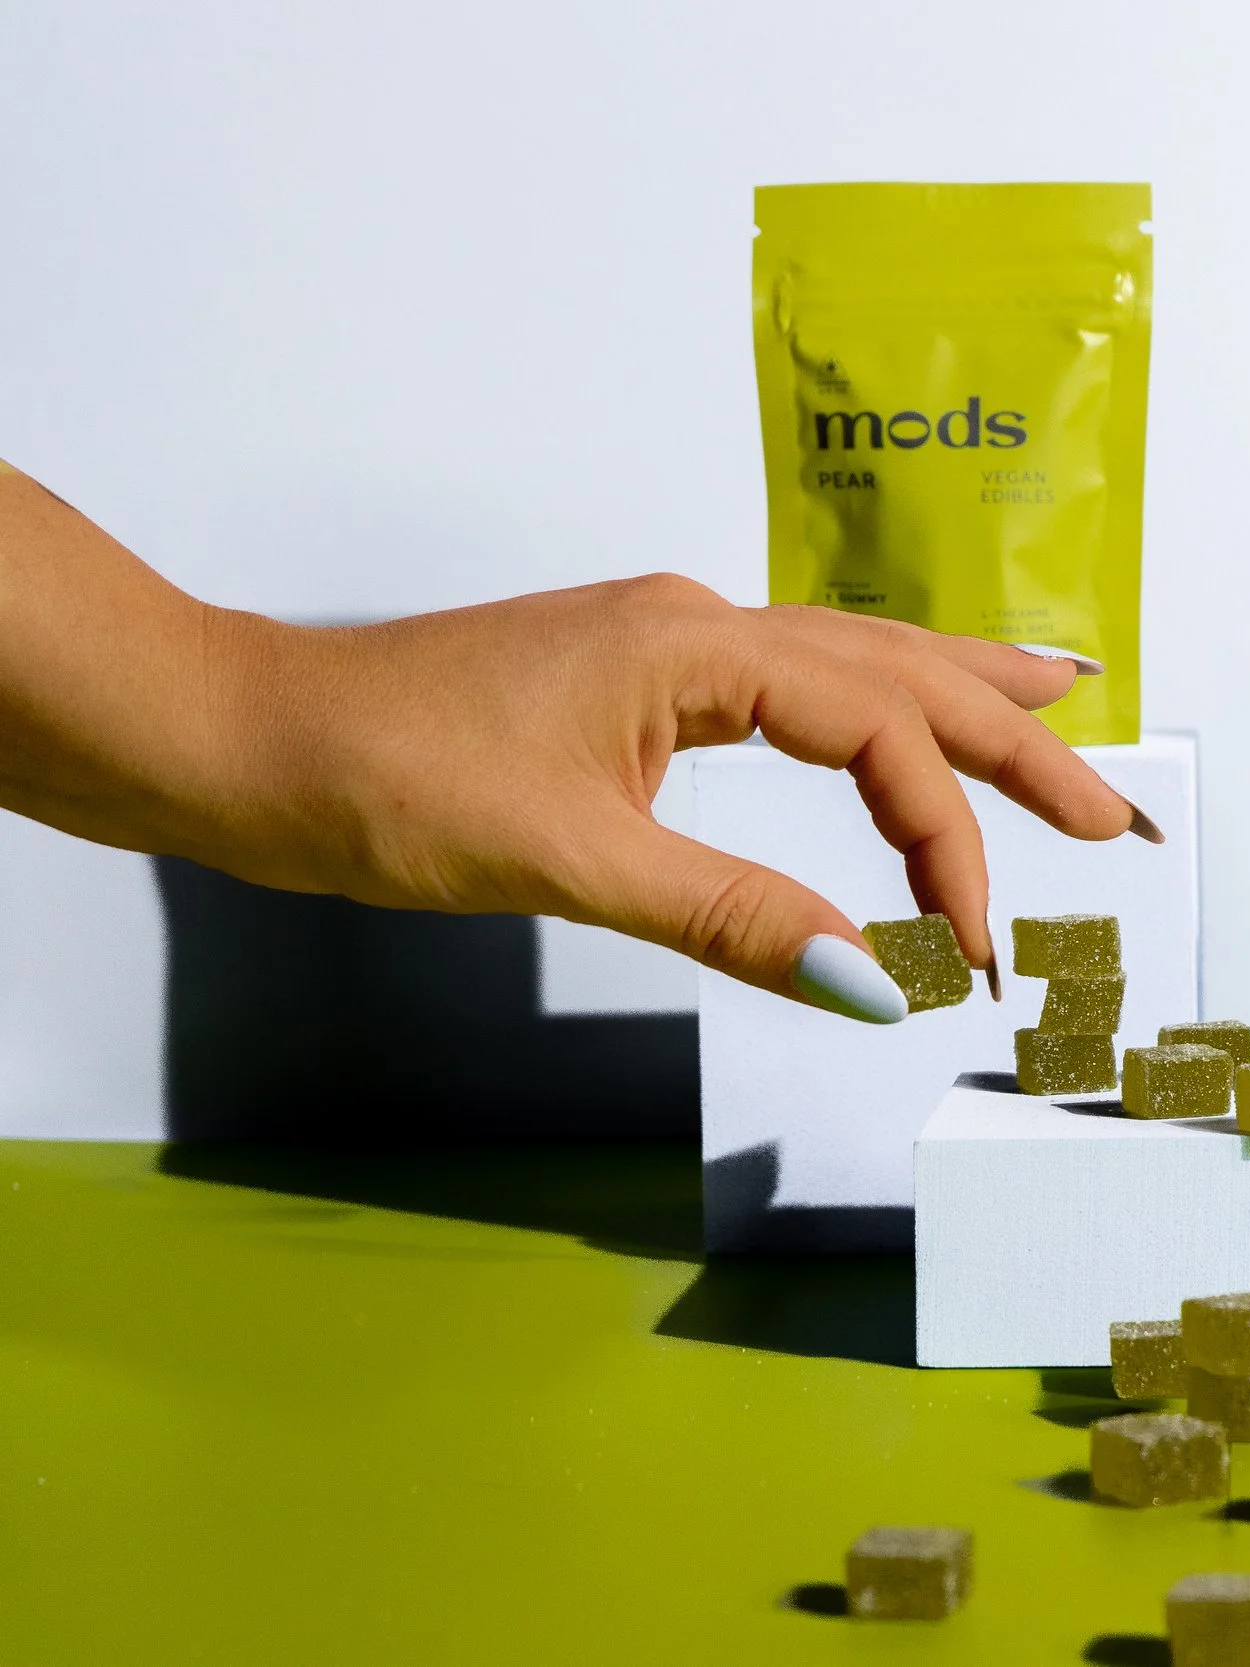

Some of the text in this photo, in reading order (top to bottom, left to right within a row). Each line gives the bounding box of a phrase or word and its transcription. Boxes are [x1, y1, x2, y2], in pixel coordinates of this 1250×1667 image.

[815, 396, 1027, 450] mods
[819, 471, 876, 490] PEAR
[980, 471, 1047, 485] VEGAN
[979, 488, 1055, 504] EDIBLES
